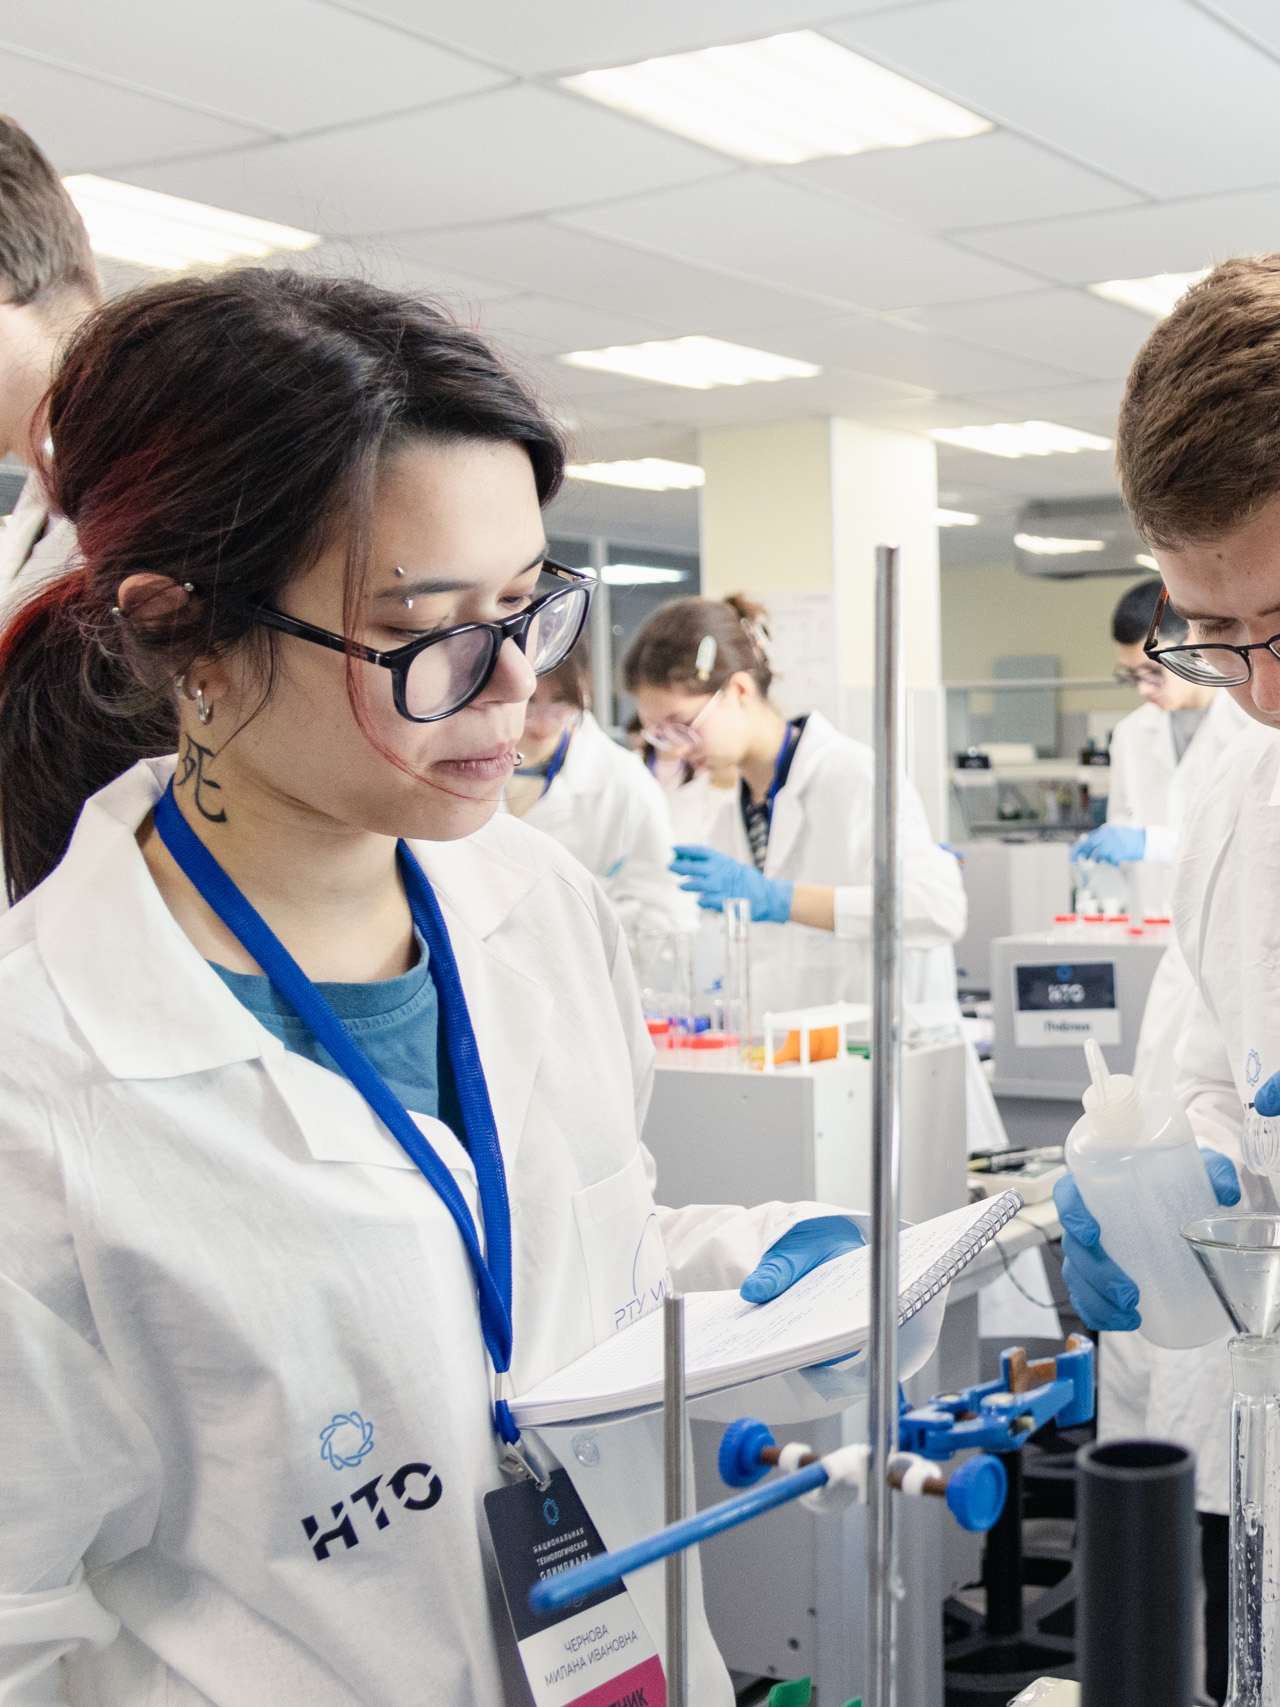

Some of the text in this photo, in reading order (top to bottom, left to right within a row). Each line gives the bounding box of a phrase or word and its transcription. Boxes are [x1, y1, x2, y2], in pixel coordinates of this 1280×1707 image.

[302, 1461, 443, 1562] НТО
[532, 1527, 585, 1554] НАЦИОНАЛЬНАЯ
[536, 1539, 589, 1566] ТЕХНОЛОГИЧЕСКАЯ
[564, 1624, 609, 1654] ЧЕРНОВА
[544, 1630, 639, 1687] МИЛАНА ИВАНОВНА
